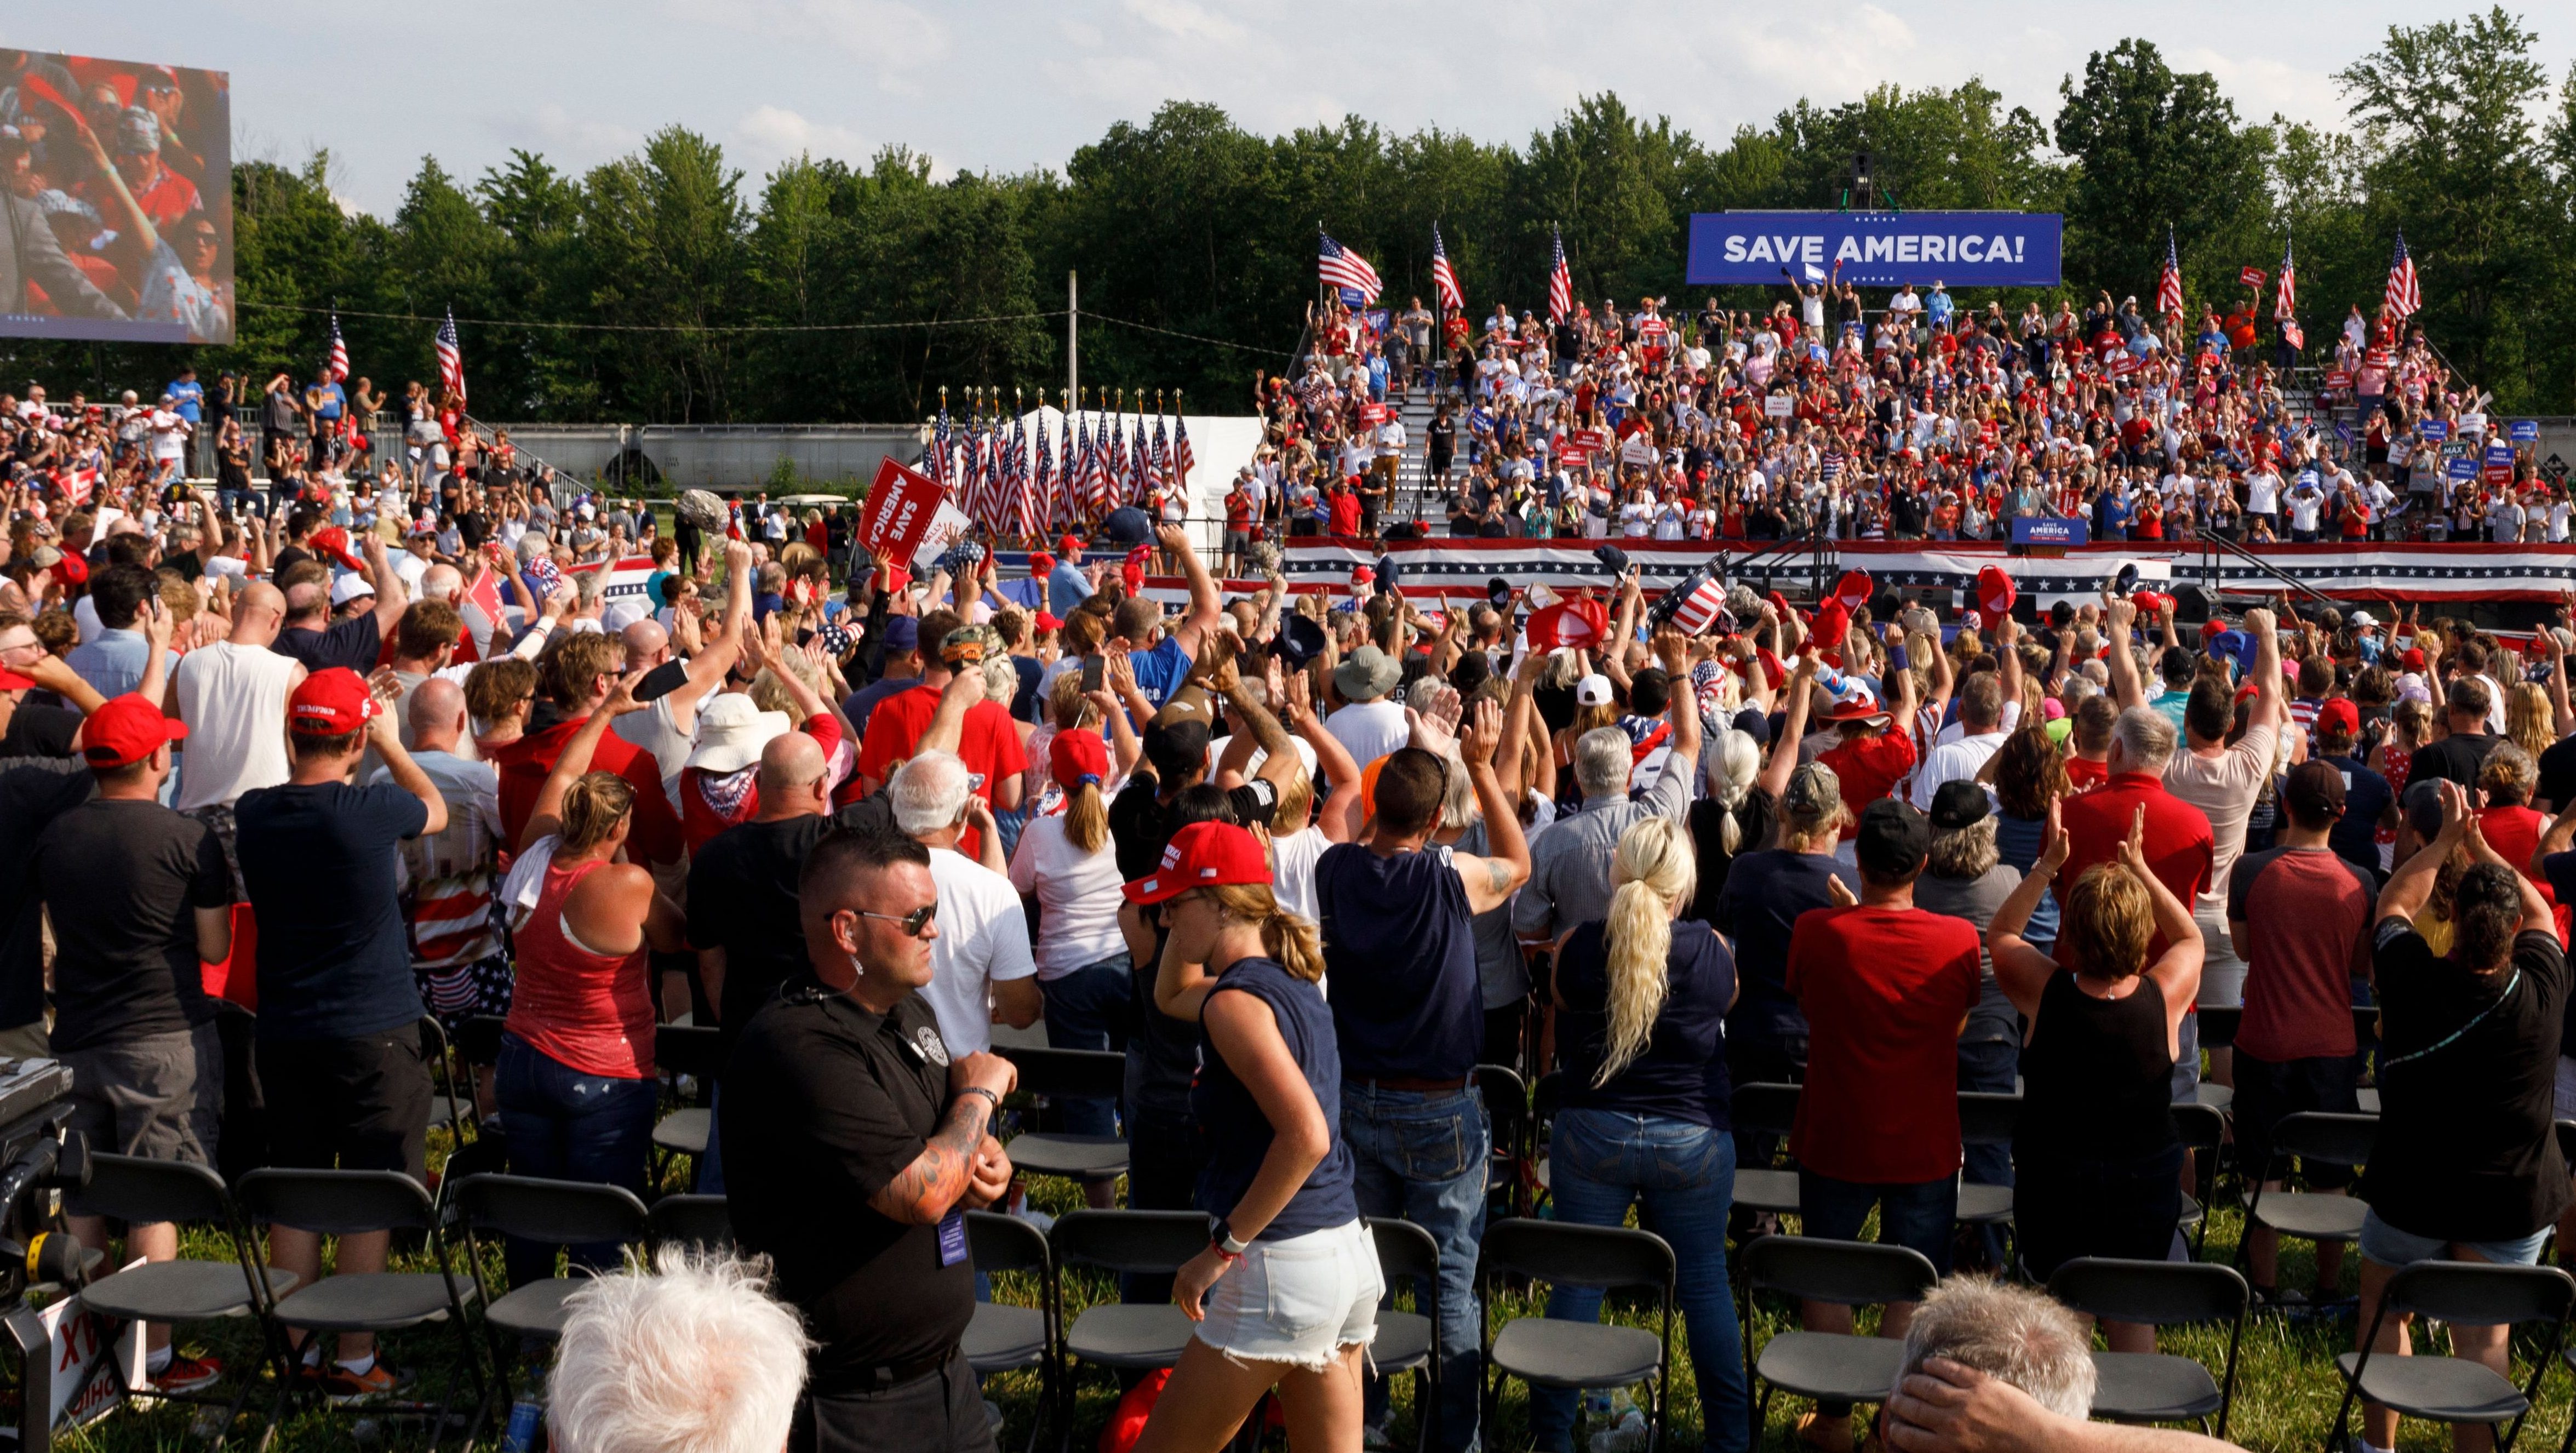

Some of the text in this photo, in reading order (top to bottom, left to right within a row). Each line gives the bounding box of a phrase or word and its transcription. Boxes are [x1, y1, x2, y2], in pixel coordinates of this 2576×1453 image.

[1723, 234, 2025, 263] SAVE AMERICA!
[2443, 445, 2463, 454] MAX
[869, 473, 907, 549] AMERICA!
[889, 499, 918, 542] SAVE
[922, 522, 942, 545] RALLY
[2030, 527, 2069, 535] AMERICA
